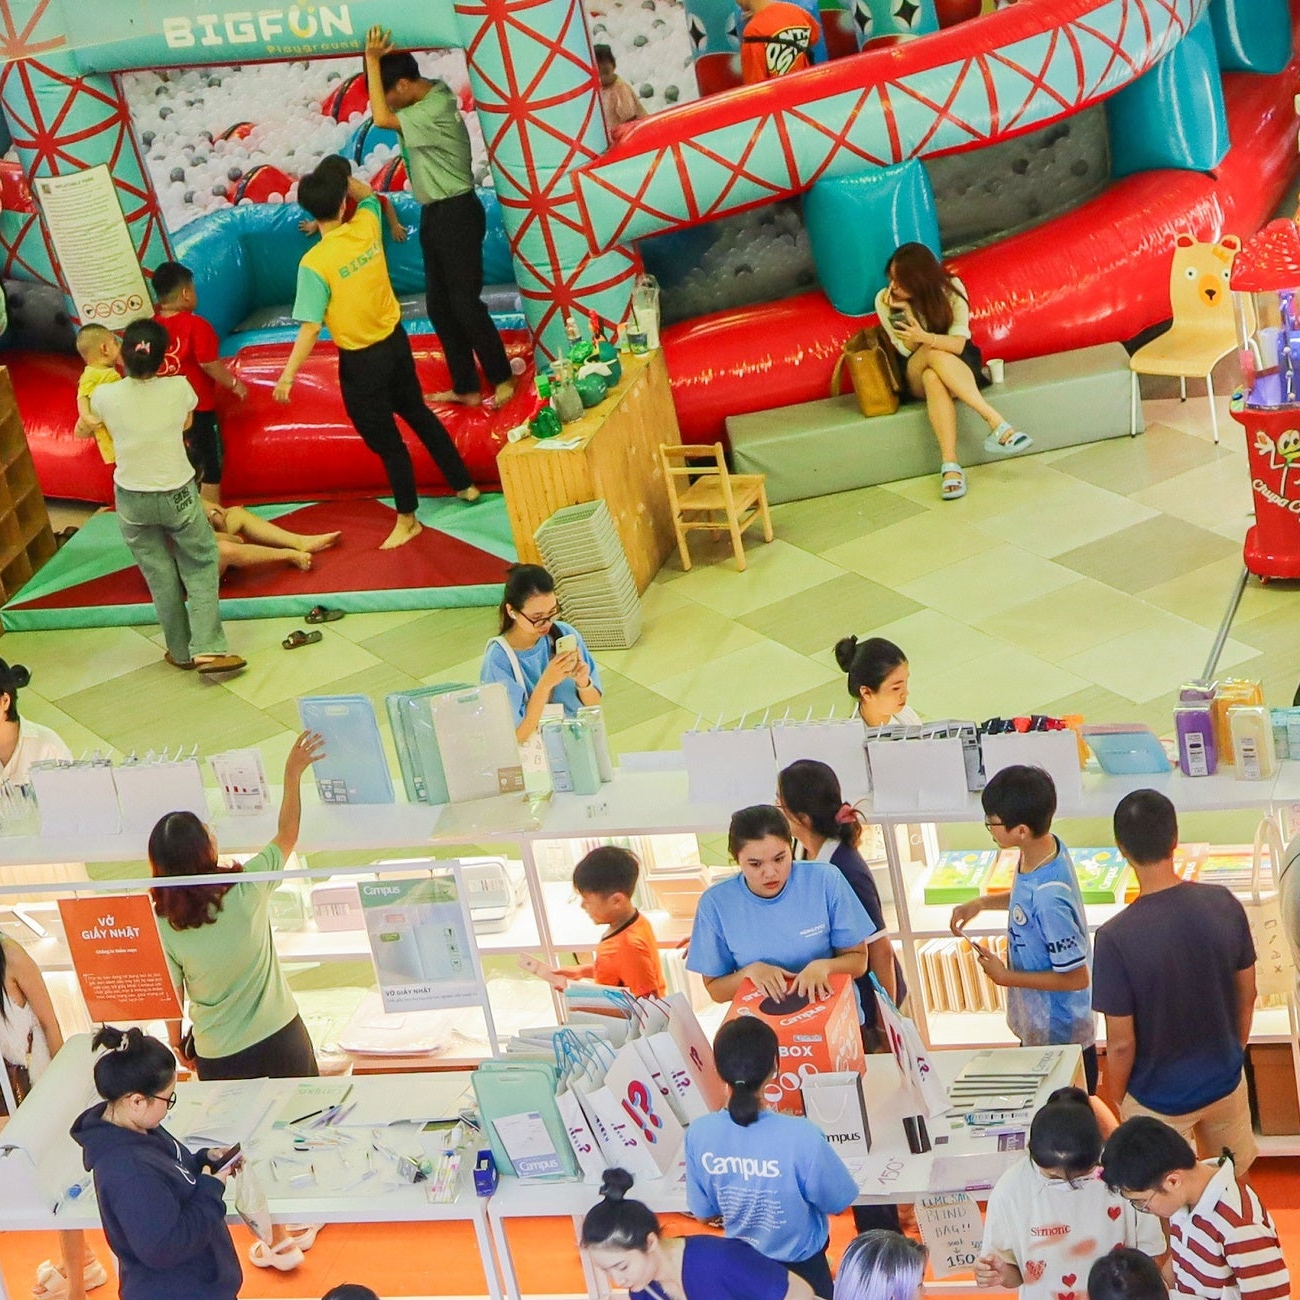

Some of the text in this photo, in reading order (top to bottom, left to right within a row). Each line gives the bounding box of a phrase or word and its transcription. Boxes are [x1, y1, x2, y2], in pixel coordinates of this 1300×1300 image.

[1252, 479, 1290, 508] Chupa
[363, 885, 401, 898] Campus
[97, 913, 115, 927] VỞ
[780, 1005, 826, 1027] Campus
[778, 1045, 813, 1057] BOX
[826, 1131, 861, 1145] mpus
[519, 1159, 558, 1174] Campus
[701, 1151, 780, 1180] Campus
